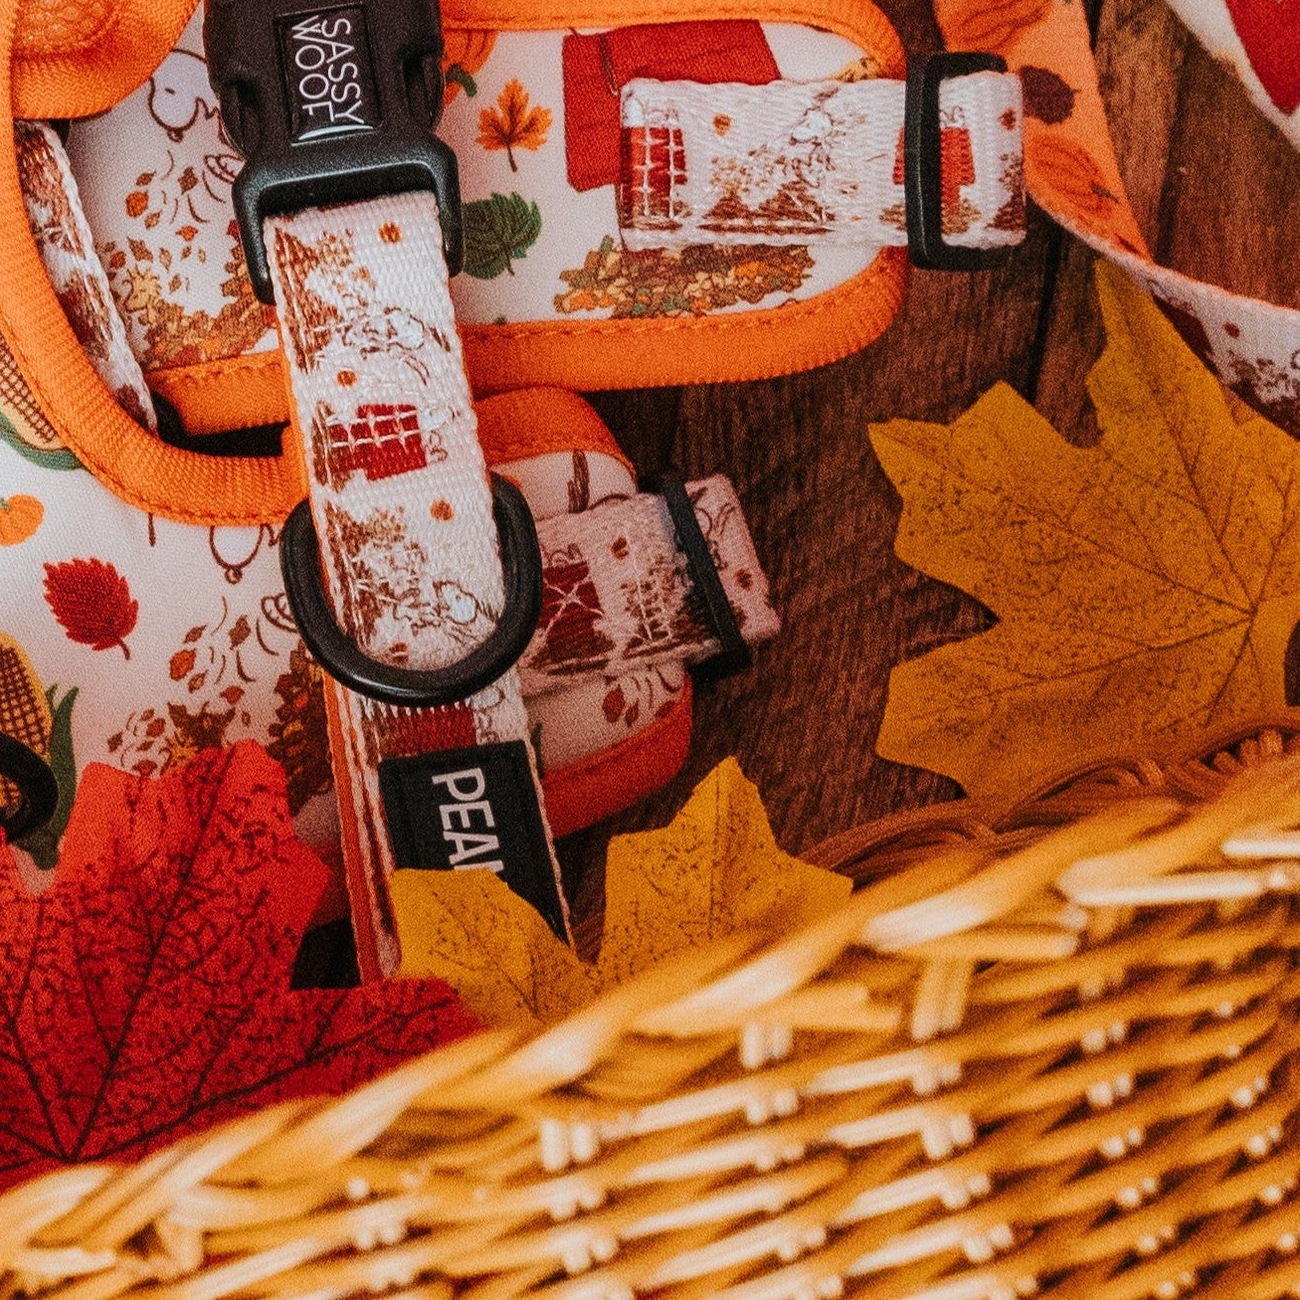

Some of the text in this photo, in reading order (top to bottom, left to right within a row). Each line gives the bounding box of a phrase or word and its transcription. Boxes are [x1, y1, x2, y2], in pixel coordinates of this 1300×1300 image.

[291, 14, 335, 123] WOOF
[321, 17, 365, 124] SASSY
[431, 767, 505, 873] PEA
